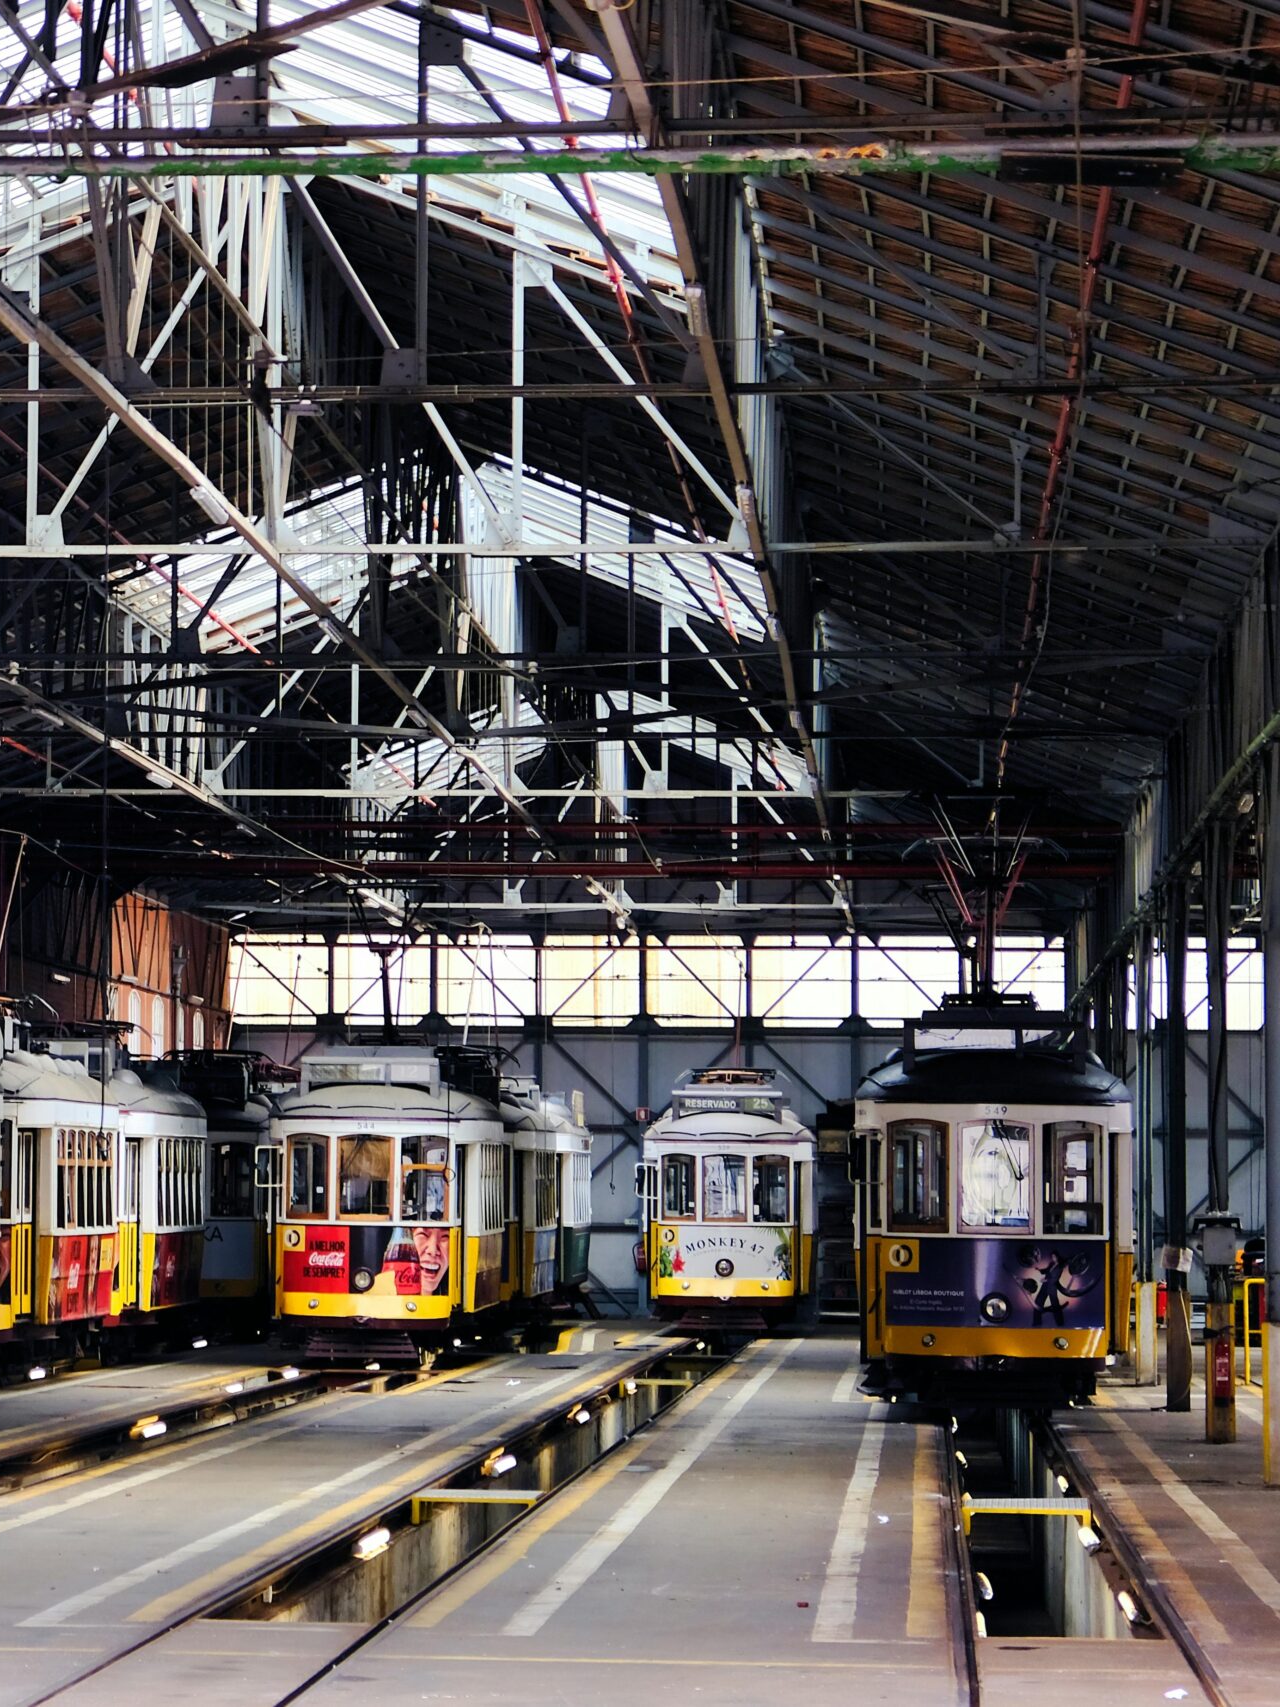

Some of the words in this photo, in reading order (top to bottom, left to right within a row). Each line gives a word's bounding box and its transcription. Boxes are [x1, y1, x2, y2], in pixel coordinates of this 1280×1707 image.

[684, 1098, 737, 1109] RESERVADO
[752, 1098, 769, 1109] 25
[984, 1105, 1008, 1115] 549
[314, 1241, 345, 1252] MELHOR
[685, 1237, 747, 1254] MONKEY
[750, 1243, 765, 1254] 47
[313, 1267, 346, 1279] SEMPRE?
